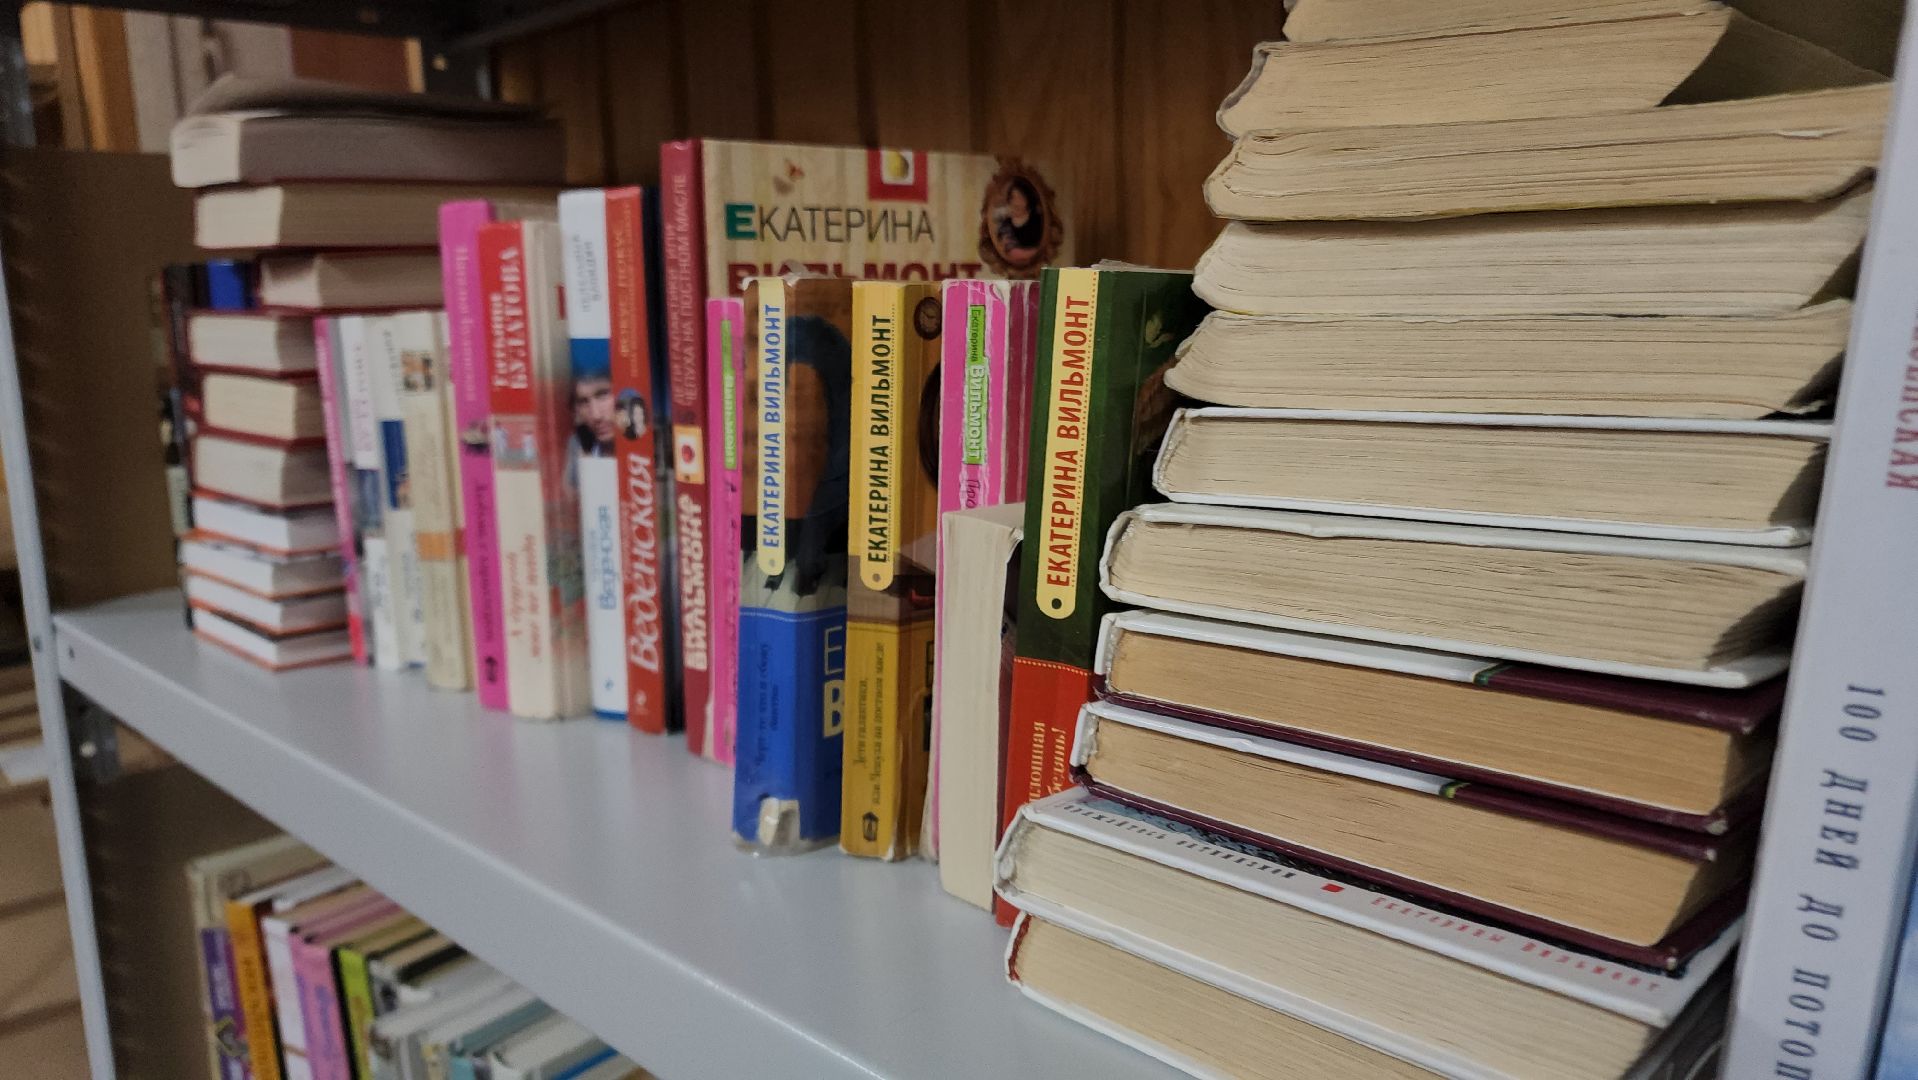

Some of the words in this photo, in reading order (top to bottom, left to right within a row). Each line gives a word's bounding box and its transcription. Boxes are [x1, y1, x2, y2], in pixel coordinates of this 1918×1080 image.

[674, 175, 689, 233] МАСЛЕ
[723, 203, 936, 244] ЕКАТЕРИНА
[677, 236, 693, 317] ПОСТНОМ
[681, 321, 694, 342] НА
[764, 304, 782, 424] ВИЛЬМОНТ
[870, 315, 892, 437] ВИЛЬМОНТ
[970, 309, 982, 362] Екатерина
[1057, 295, 1090, 440] ВИЛЬМОНТ
[967, 364, 985, 459] Вильмонт
[762, 432, 782, 548] ЕКАТЕРИНА
[867, 444, 889, 563] ЕКАТЕРИНА
[1046, 449, 1079, 587] ЕКАТЕРИНА
[626, 453, 660, 673] Веденская
[1839, 684, 1886, 743] 100
[1028, 721, 1046, 804] плошная
[1813, 768, 1870, 871] ДНЕЙ
[1796, 893, 1844, 943] ДО
